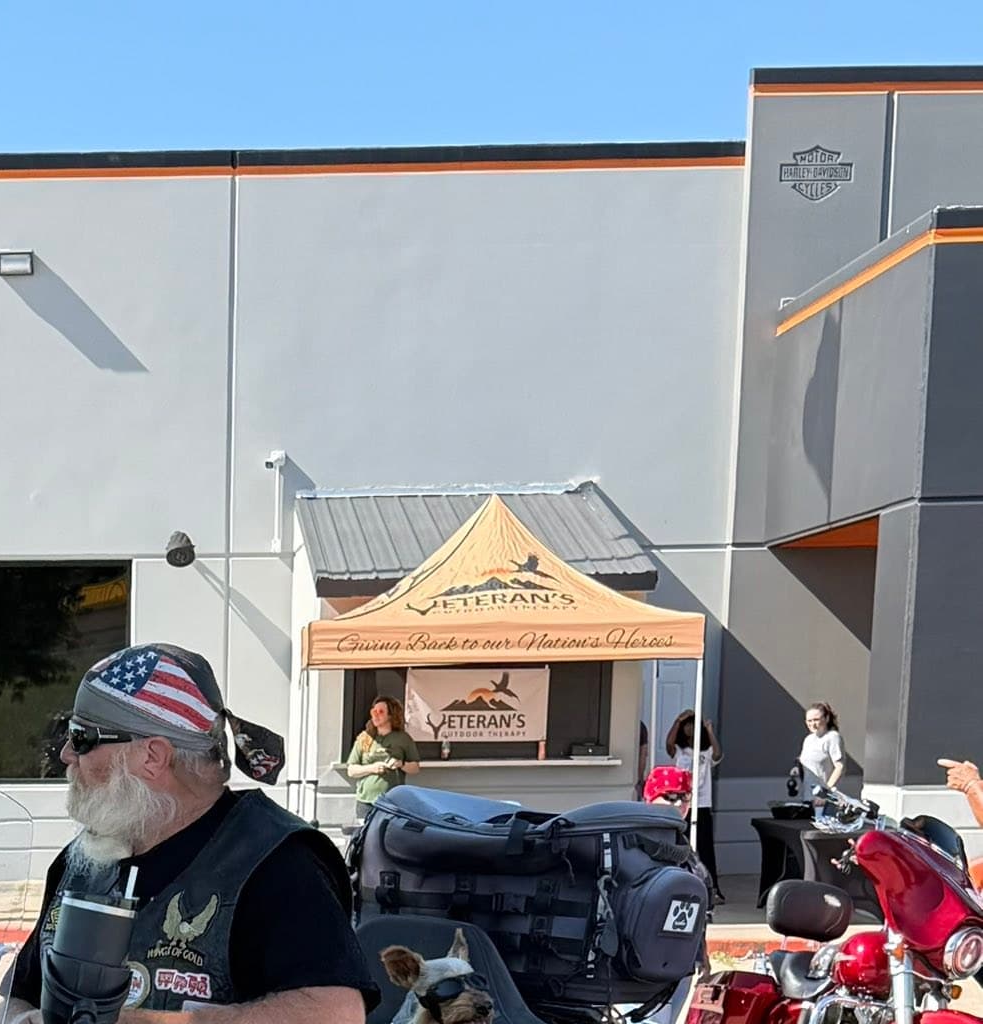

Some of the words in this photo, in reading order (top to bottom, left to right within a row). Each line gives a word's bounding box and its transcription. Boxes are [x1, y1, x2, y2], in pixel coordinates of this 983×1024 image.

[799, 150, 834, 163] MOTOR
[783, 166, 849, 178] HARLEY-DAVIDSON
[797, 182, 833, 198] CYCLES
[336, 632, 402, 656] Giving
[405, 631, 460, 651] Back
[462, 637, 479, 651] to
[482, 639, 514, 651] our
[518, 630, 602, 652] Nation's
[606, 626, 676, 650] Heroes
[488, 730, 526, 738] THERAPY
[183, 950, 204, 967] GOLD
